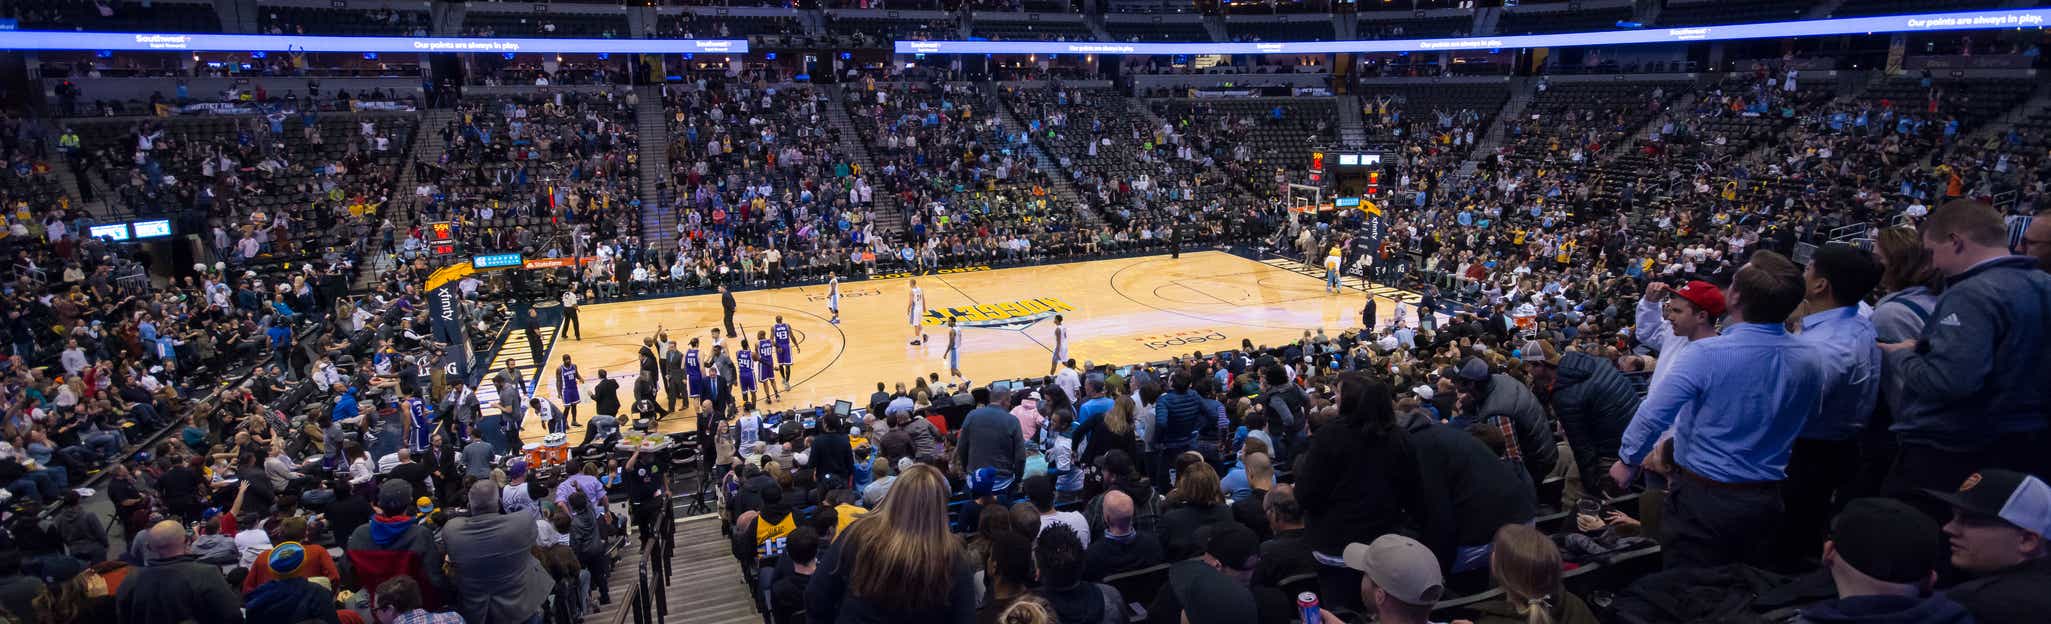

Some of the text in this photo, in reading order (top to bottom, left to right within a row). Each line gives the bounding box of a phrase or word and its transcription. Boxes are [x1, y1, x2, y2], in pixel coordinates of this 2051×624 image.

[1907, 13, 2043, 28] Our points are always in play.
[136, 34, 185, 42] Southwest
[414, 41, 429, 49] Our
[430, 40, 454, 51] points
[468, 41, 493, 51] always
[494, 41, 502, 49] in
[502, 41, 520, 51] play.
[1370, 216, 1379, 240] xfinity
[437, 287, 454, 321] xfinity
[1144, 332, 1226, 350] pepsi
[687, 357, 697, 367] 41
[738, 358, 750, 369] 24
[416, 405, 423, 417] 3
